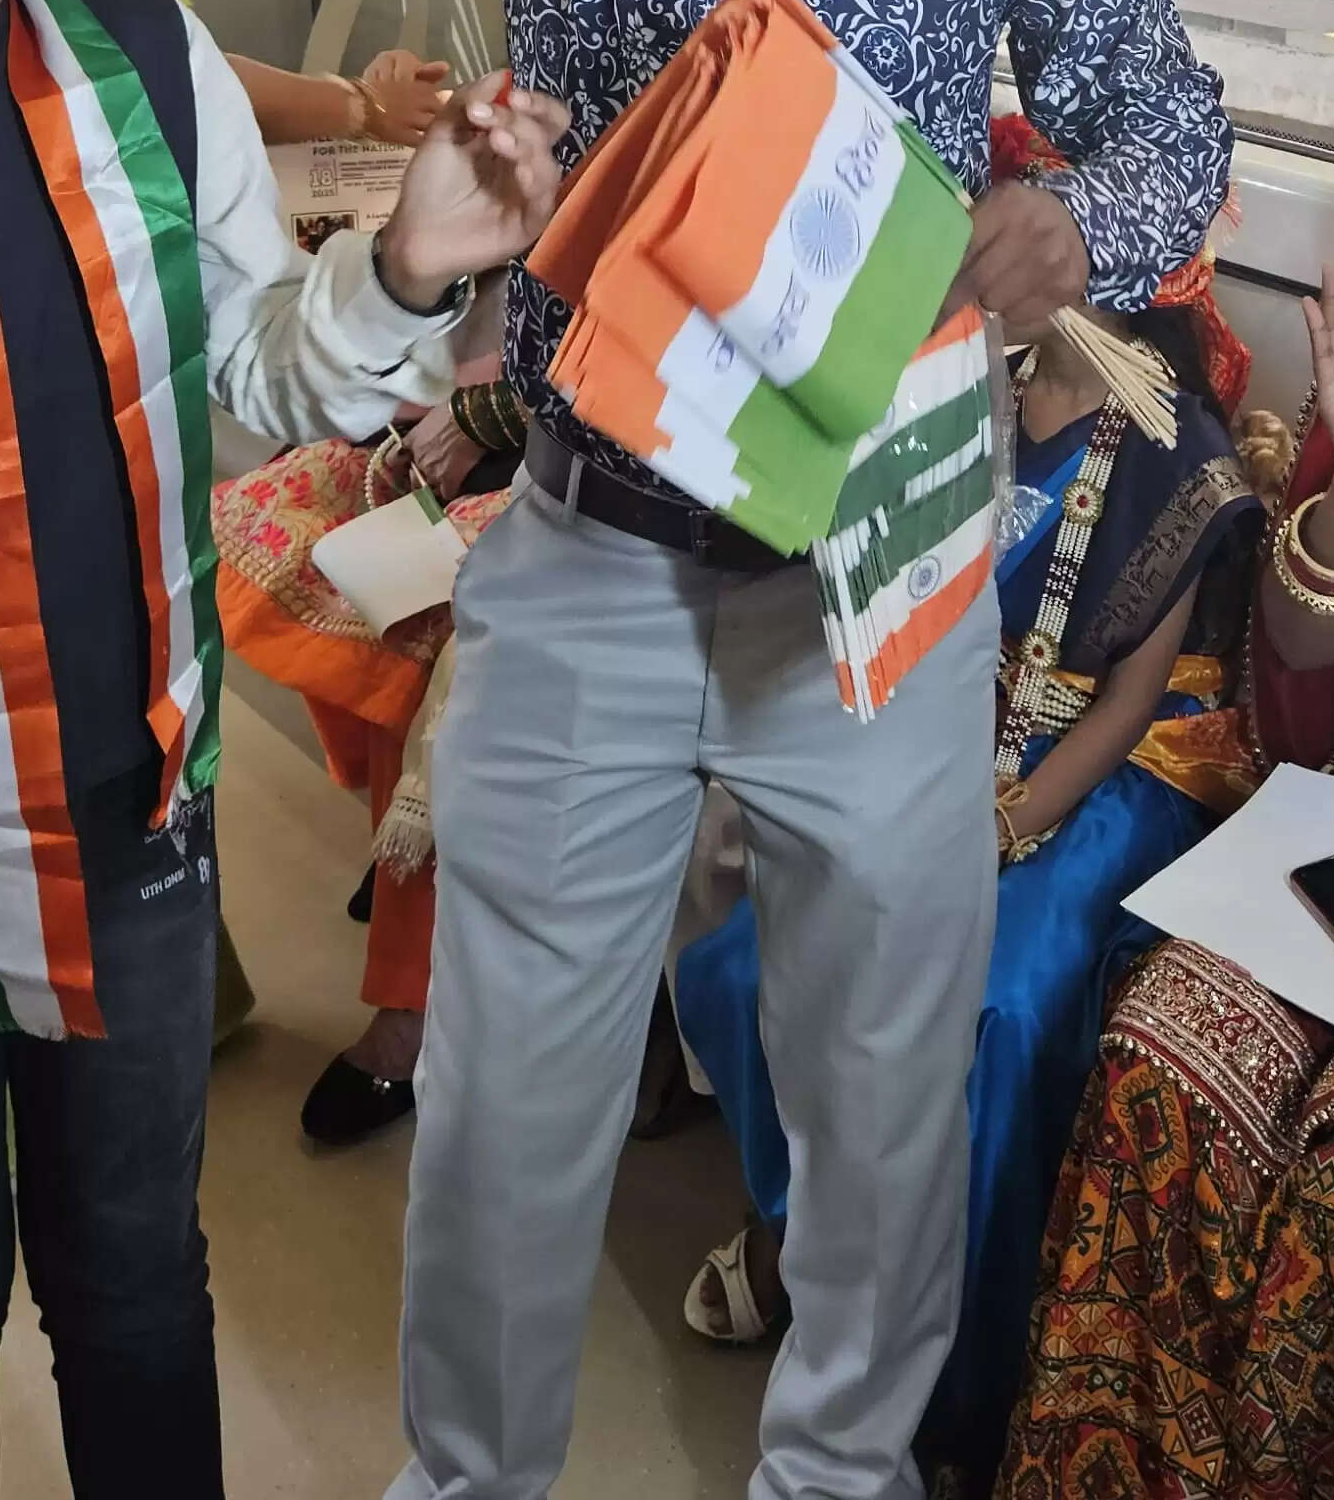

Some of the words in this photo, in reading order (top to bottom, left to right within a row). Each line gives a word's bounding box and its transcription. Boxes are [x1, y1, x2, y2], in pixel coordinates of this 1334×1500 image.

[313, 146, 336, 156] FOR
[338, 144, 359, 154] THE
[308, 168, 333, 188] 18
